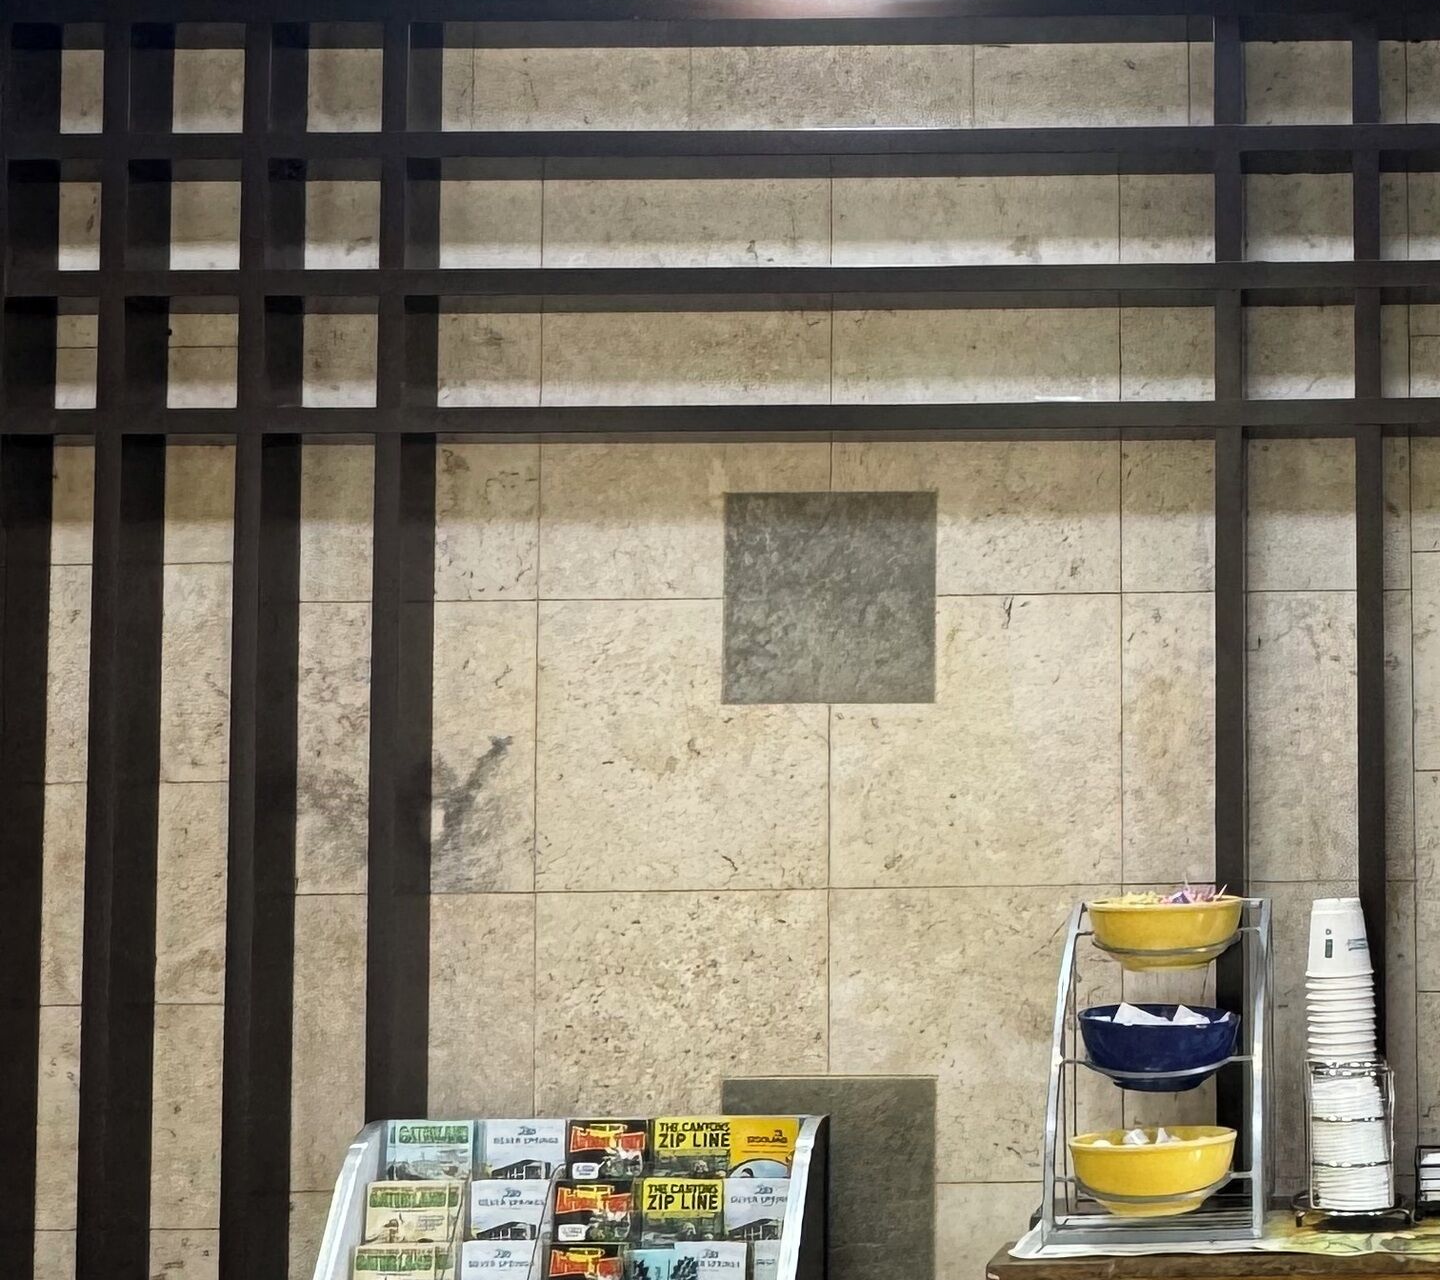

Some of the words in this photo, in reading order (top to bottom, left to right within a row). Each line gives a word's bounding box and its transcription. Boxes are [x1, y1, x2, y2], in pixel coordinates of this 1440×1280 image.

[659, 1133, 686, 1148] ZIP
[693, 1133, 731, 1148] LINE
[647, 1195, 675, 1210] ZIP
[681, 1194, 718, 1210] LINE
